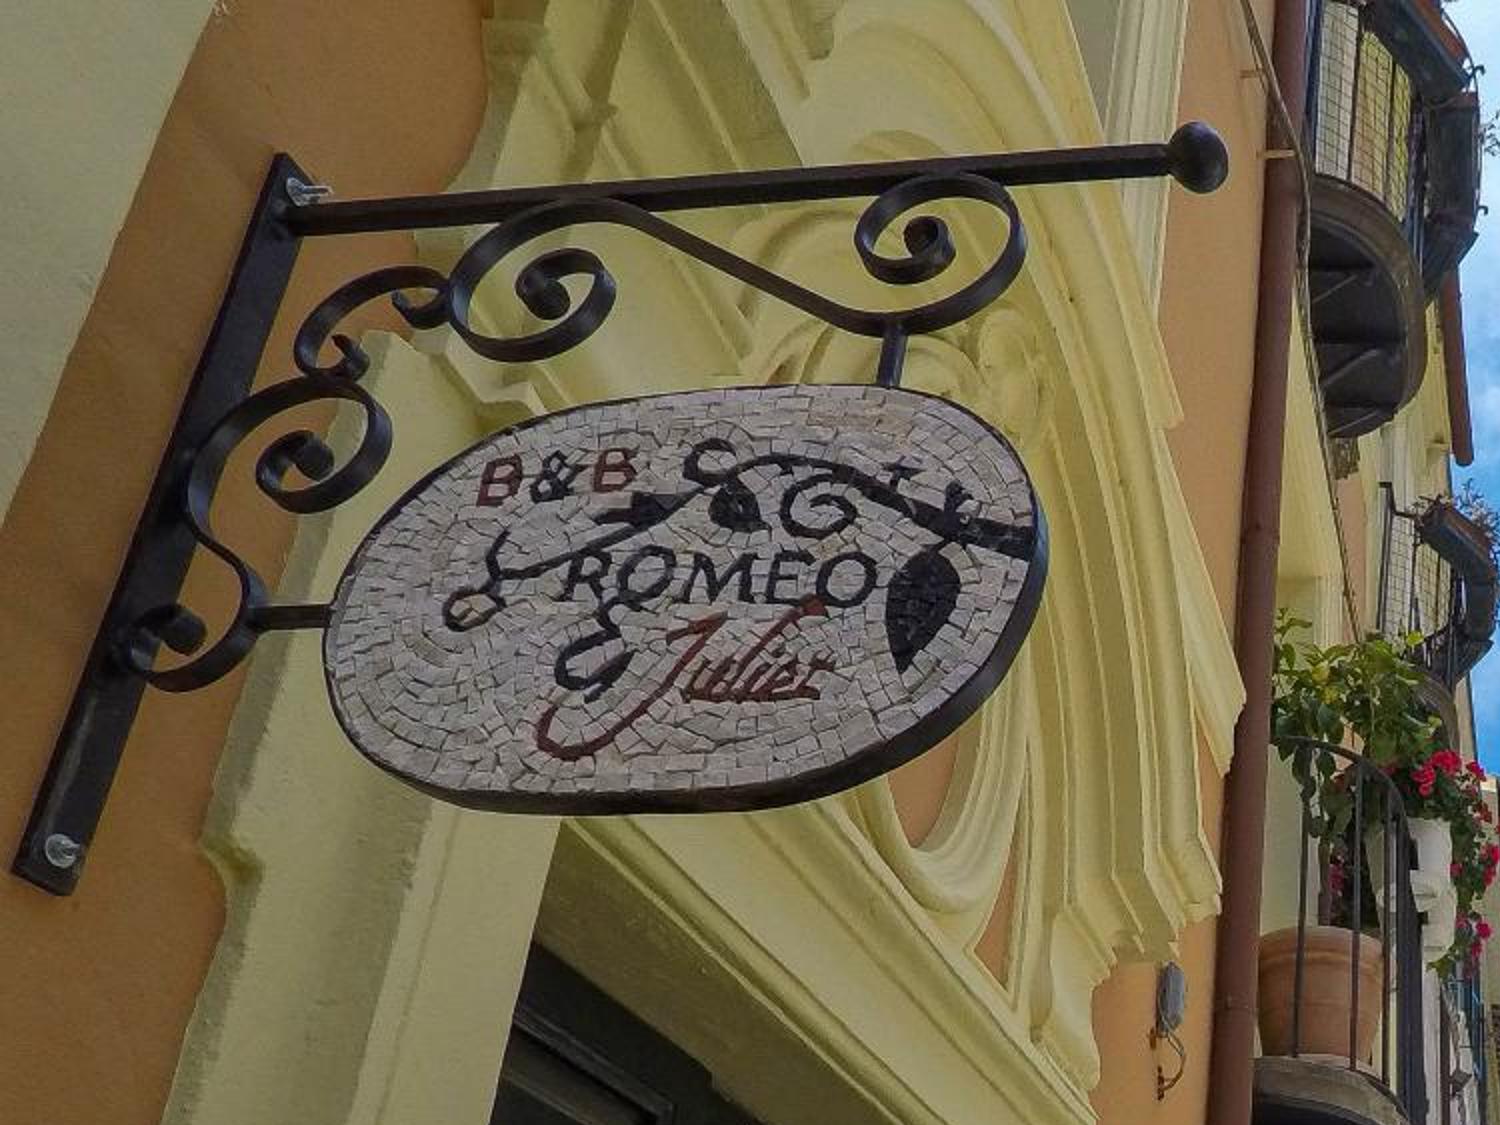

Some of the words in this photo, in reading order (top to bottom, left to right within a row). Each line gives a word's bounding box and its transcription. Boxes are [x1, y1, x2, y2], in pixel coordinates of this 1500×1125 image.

[475, 445, 638, 508] B&B
[560, 543, 879, 608] ROMEO
[534, 594, 839, 762] Juliet
